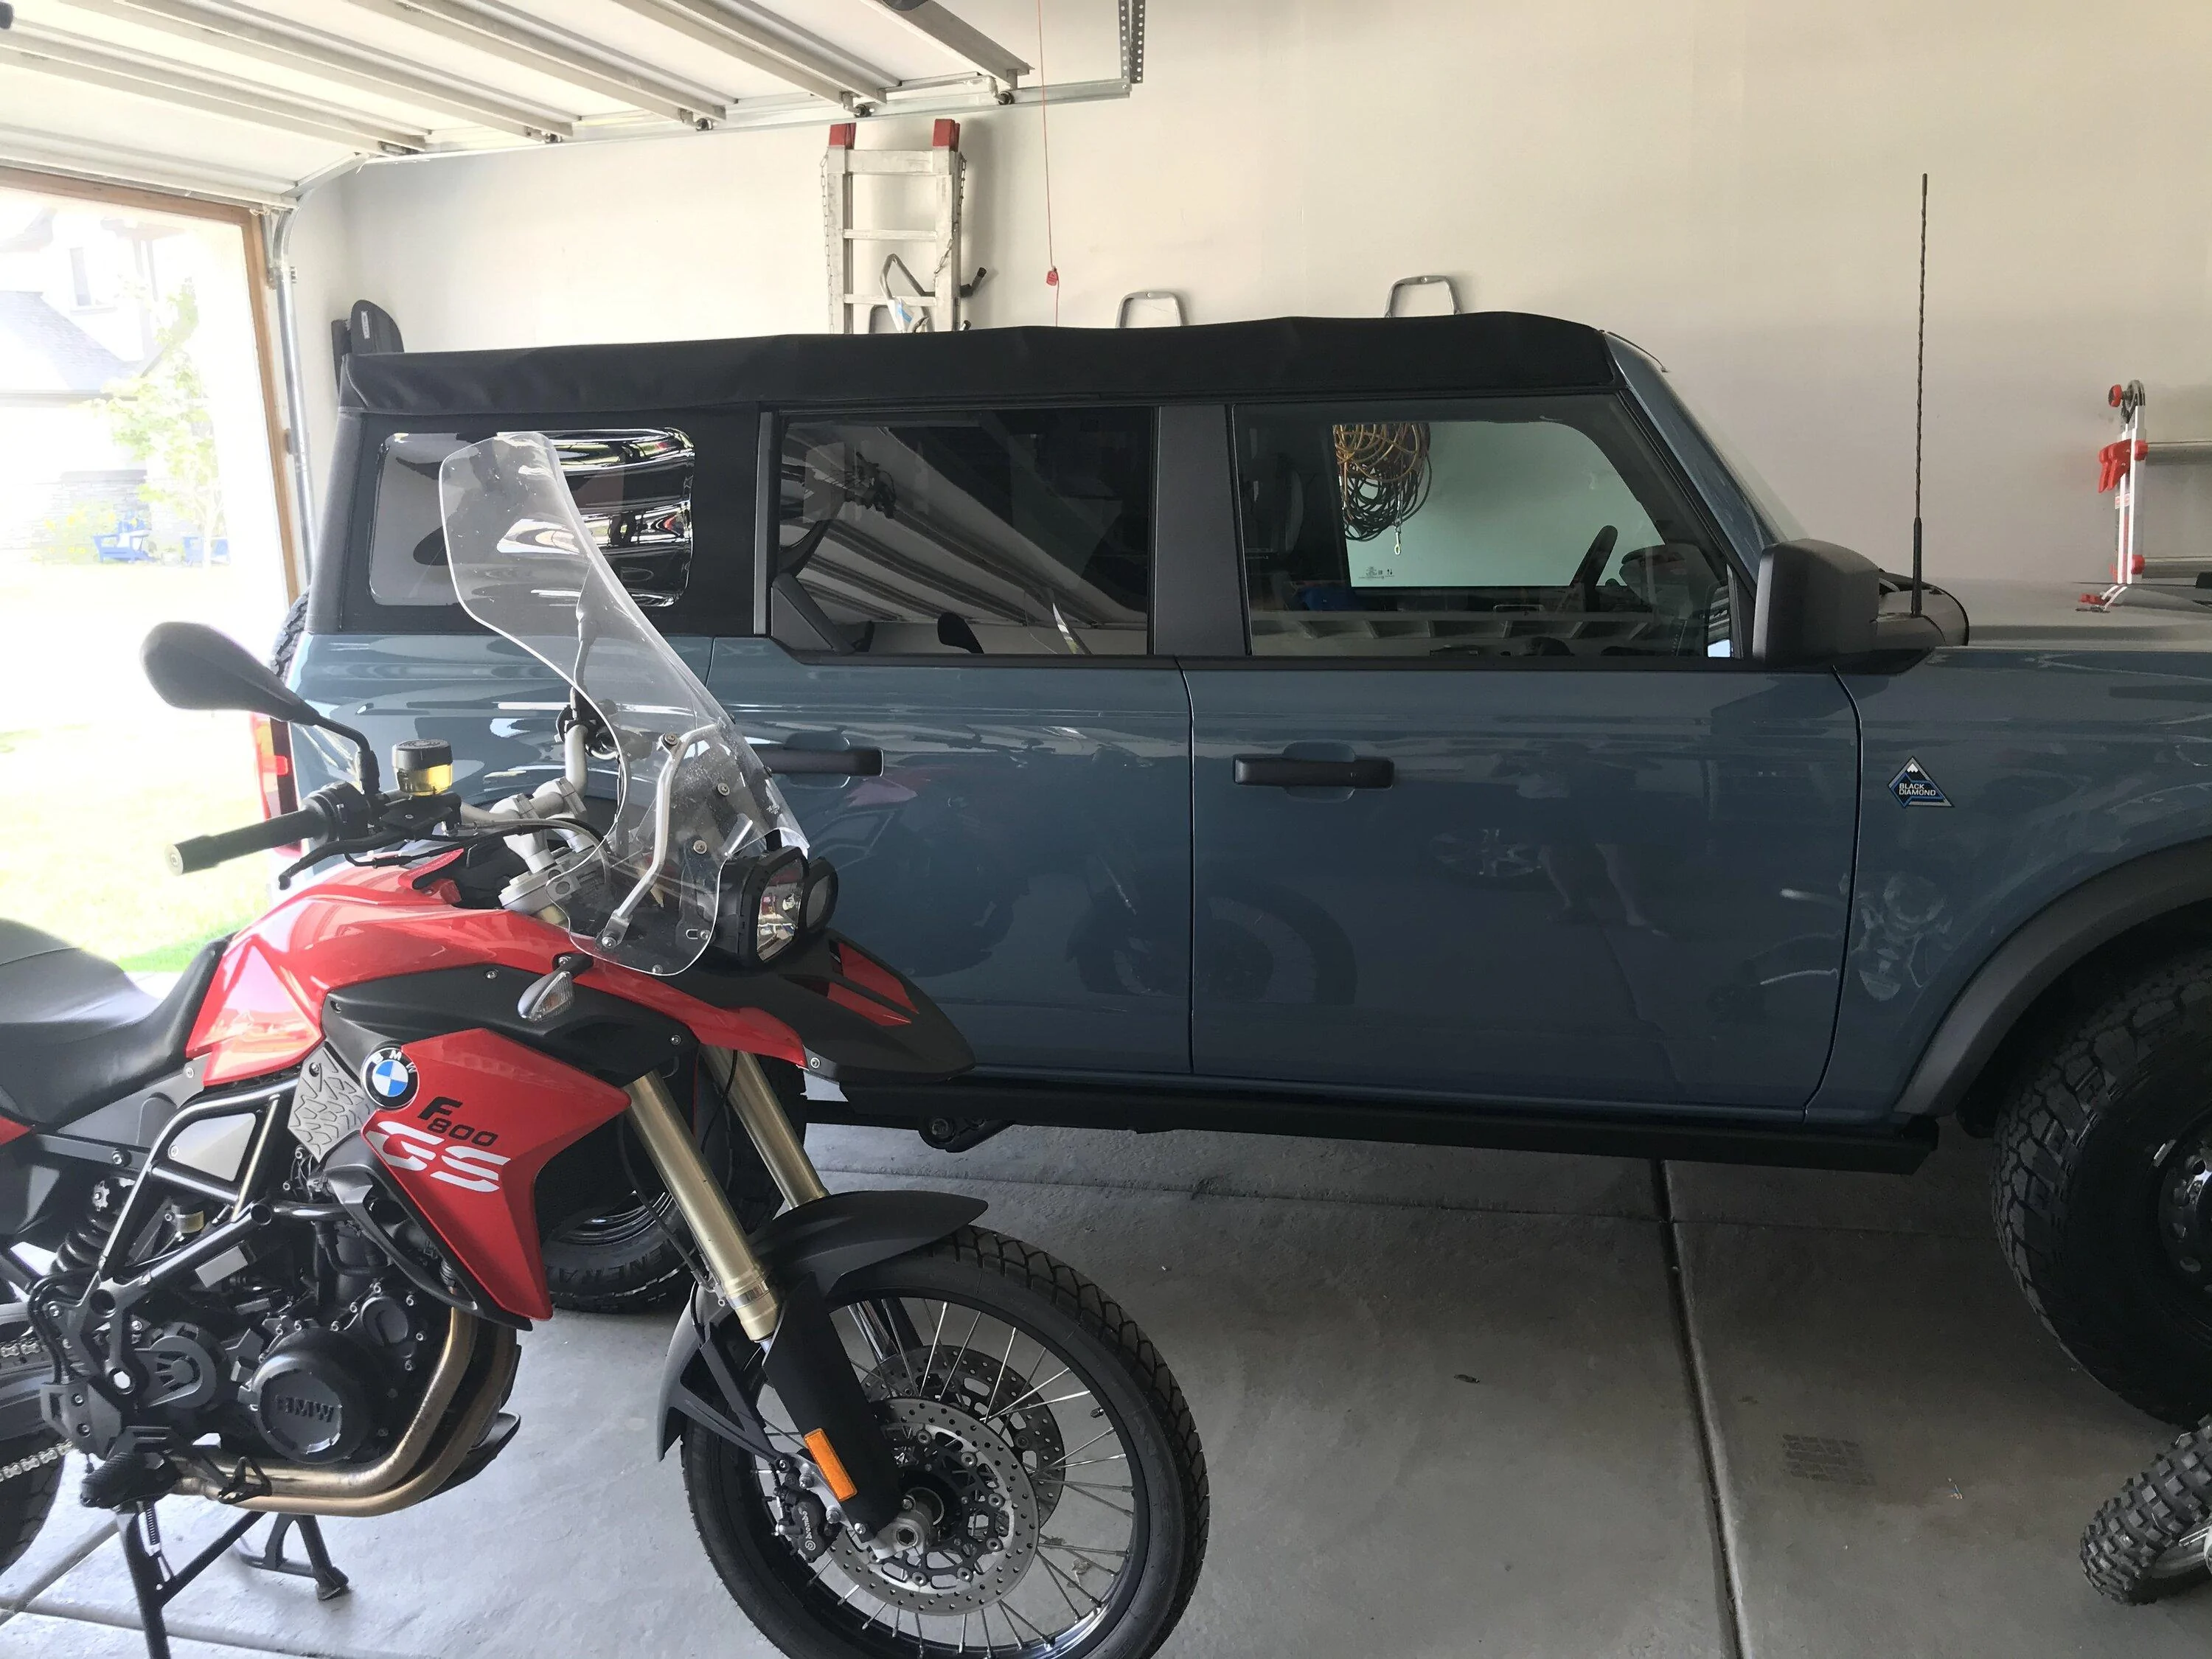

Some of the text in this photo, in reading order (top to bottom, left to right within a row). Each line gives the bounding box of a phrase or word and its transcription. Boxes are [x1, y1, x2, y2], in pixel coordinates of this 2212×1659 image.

[371, 1049, 418, 1074] BMW
[417, 1096, 463, 1121] F
[427, 1119, 498, 1147] 800
[364, 1121, 512, 1192] GS
